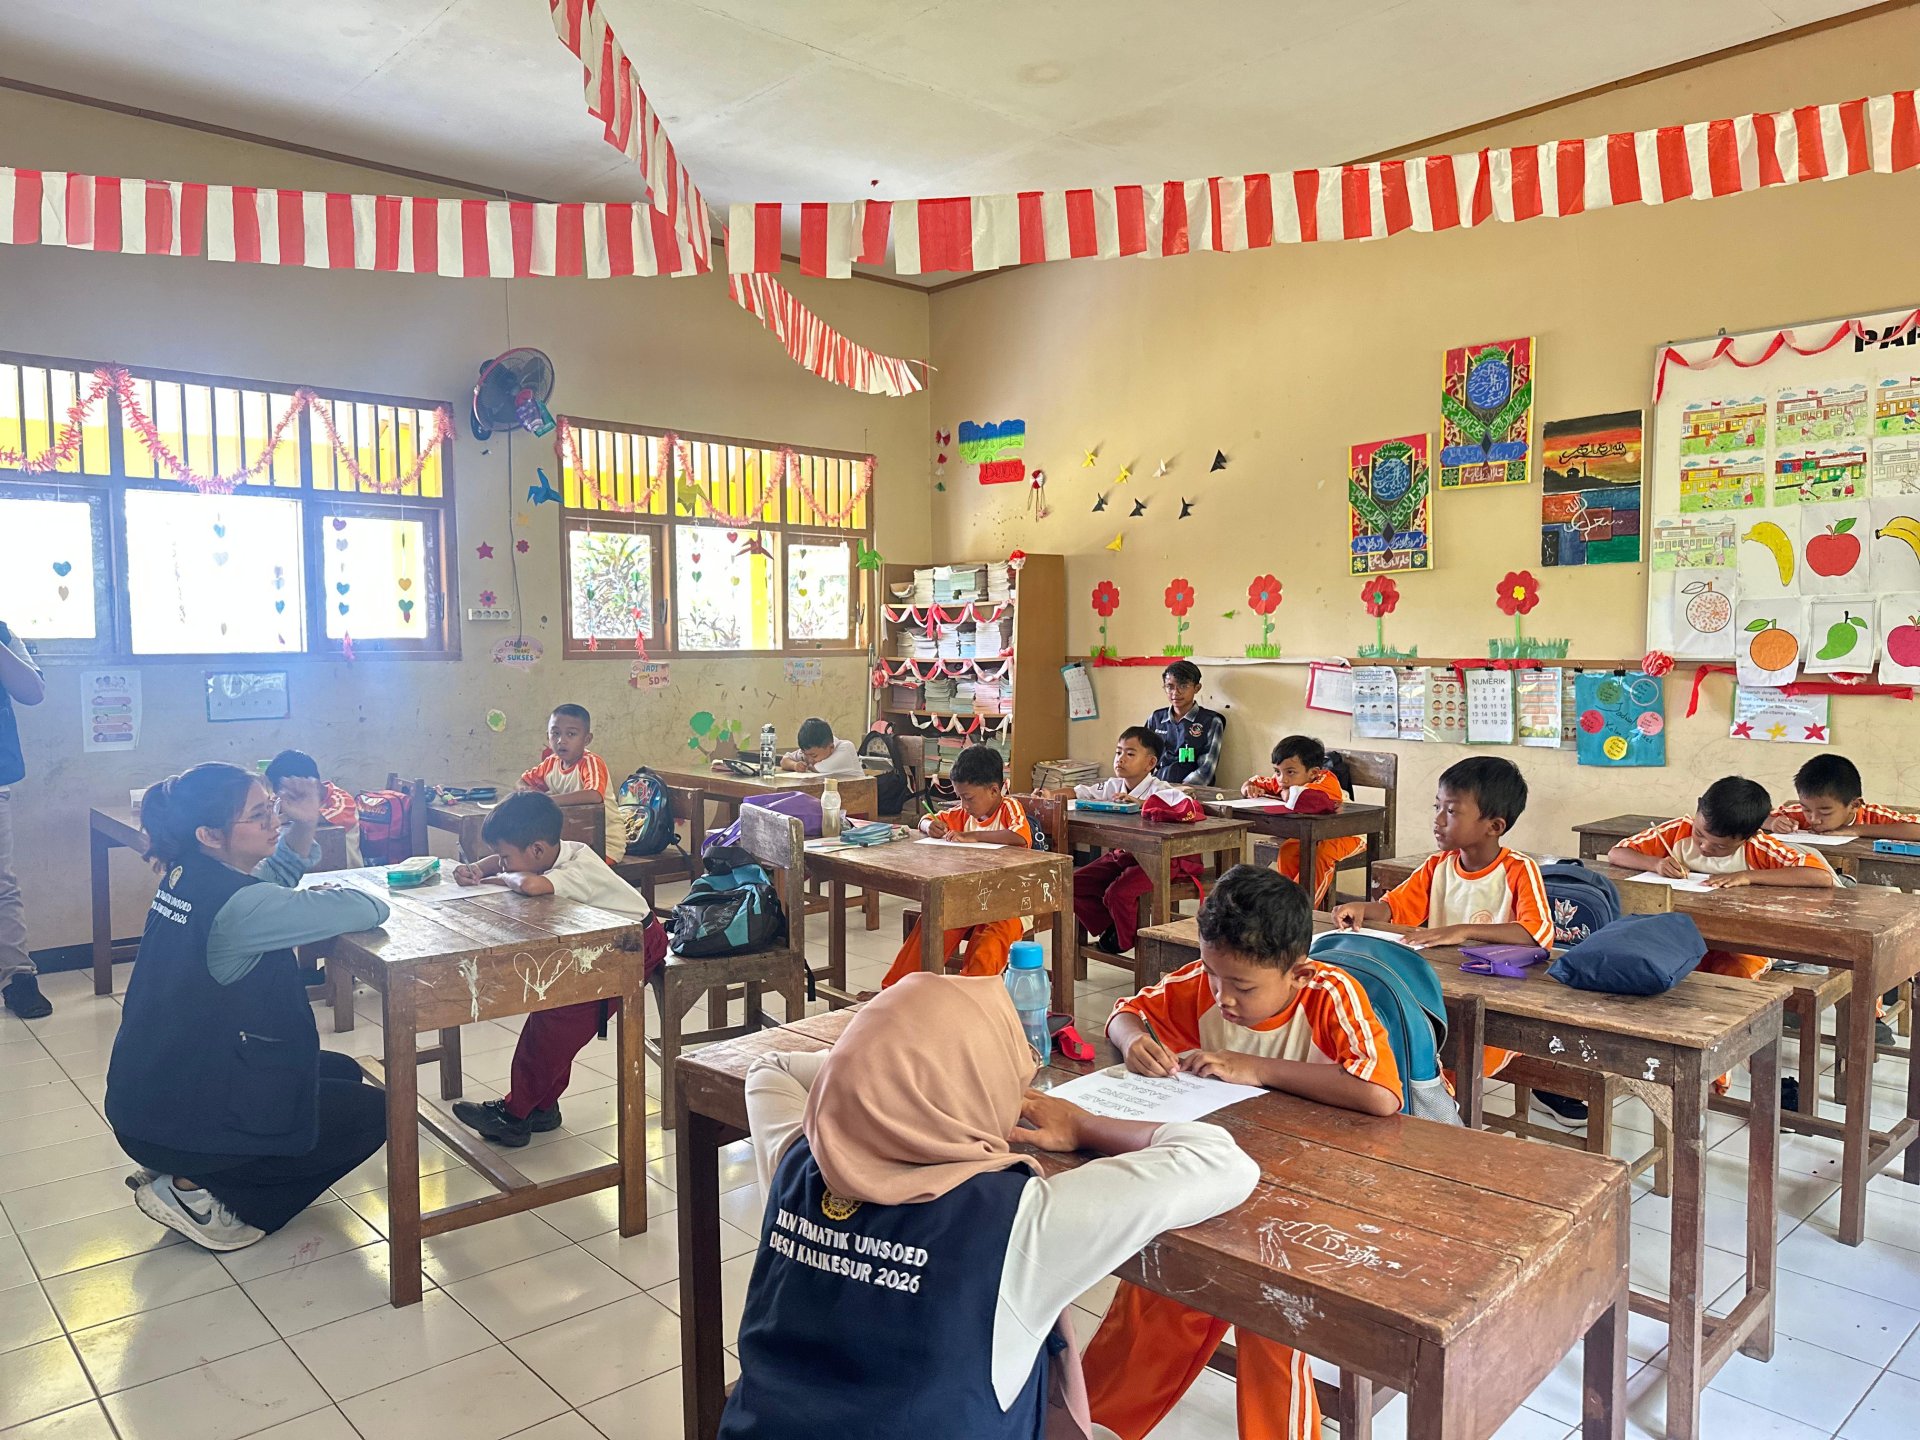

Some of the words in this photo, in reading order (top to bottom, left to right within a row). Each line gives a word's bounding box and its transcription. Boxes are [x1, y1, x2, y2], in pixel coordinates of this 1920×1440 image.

[1855, 325, 1920, 352] PA
[504, 640, 529, 648] CAN
[170, 912, 188, 925] 2026
[797, 1217, 850, 1250] TEMATIK
[854, 1234, 929, 1268] UNSOED
[769, 1231, 796, 1259] DESA
[796, 1244, 872, 1283] KALIKESUR
[873, 1267, 922, 1294] 2026
